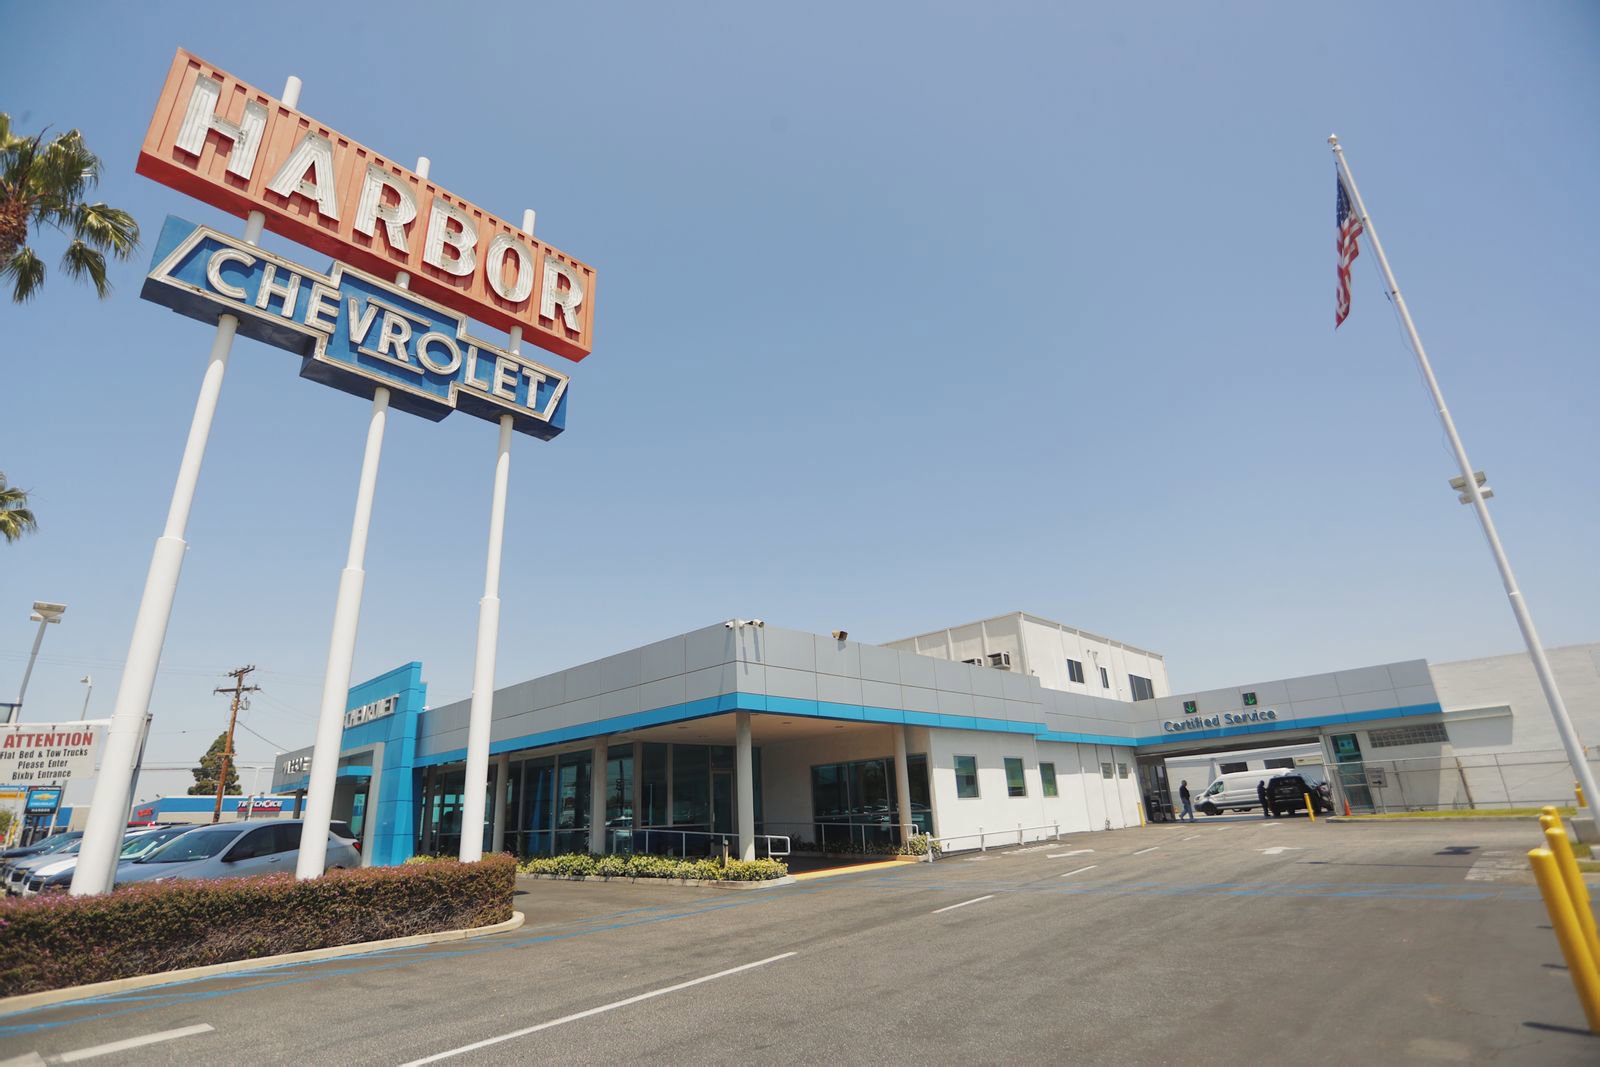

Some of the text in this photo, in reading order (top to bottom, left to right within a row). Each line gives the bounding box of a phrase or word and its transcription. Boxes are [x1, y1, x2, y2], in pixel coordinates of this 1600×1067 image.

[174, 72, 585, 333] HARBOR
[206, 247, 547, 409] CHEVROLET
[1164, 709, 1276, 732] Certified Service
[3, 732, 93, 748] ATTENTION
[19, 750, 34, 759] Bed
[38, 750, 43, 758] &
[46, 748, 61, 758] Tow
[63, 748, 88, 757] Trucks
[17, 759, 68, 770] Please Enter
[12, 770, 71, 781] Bixby Entrance
[254, 799, 284, 808] CHOICE
